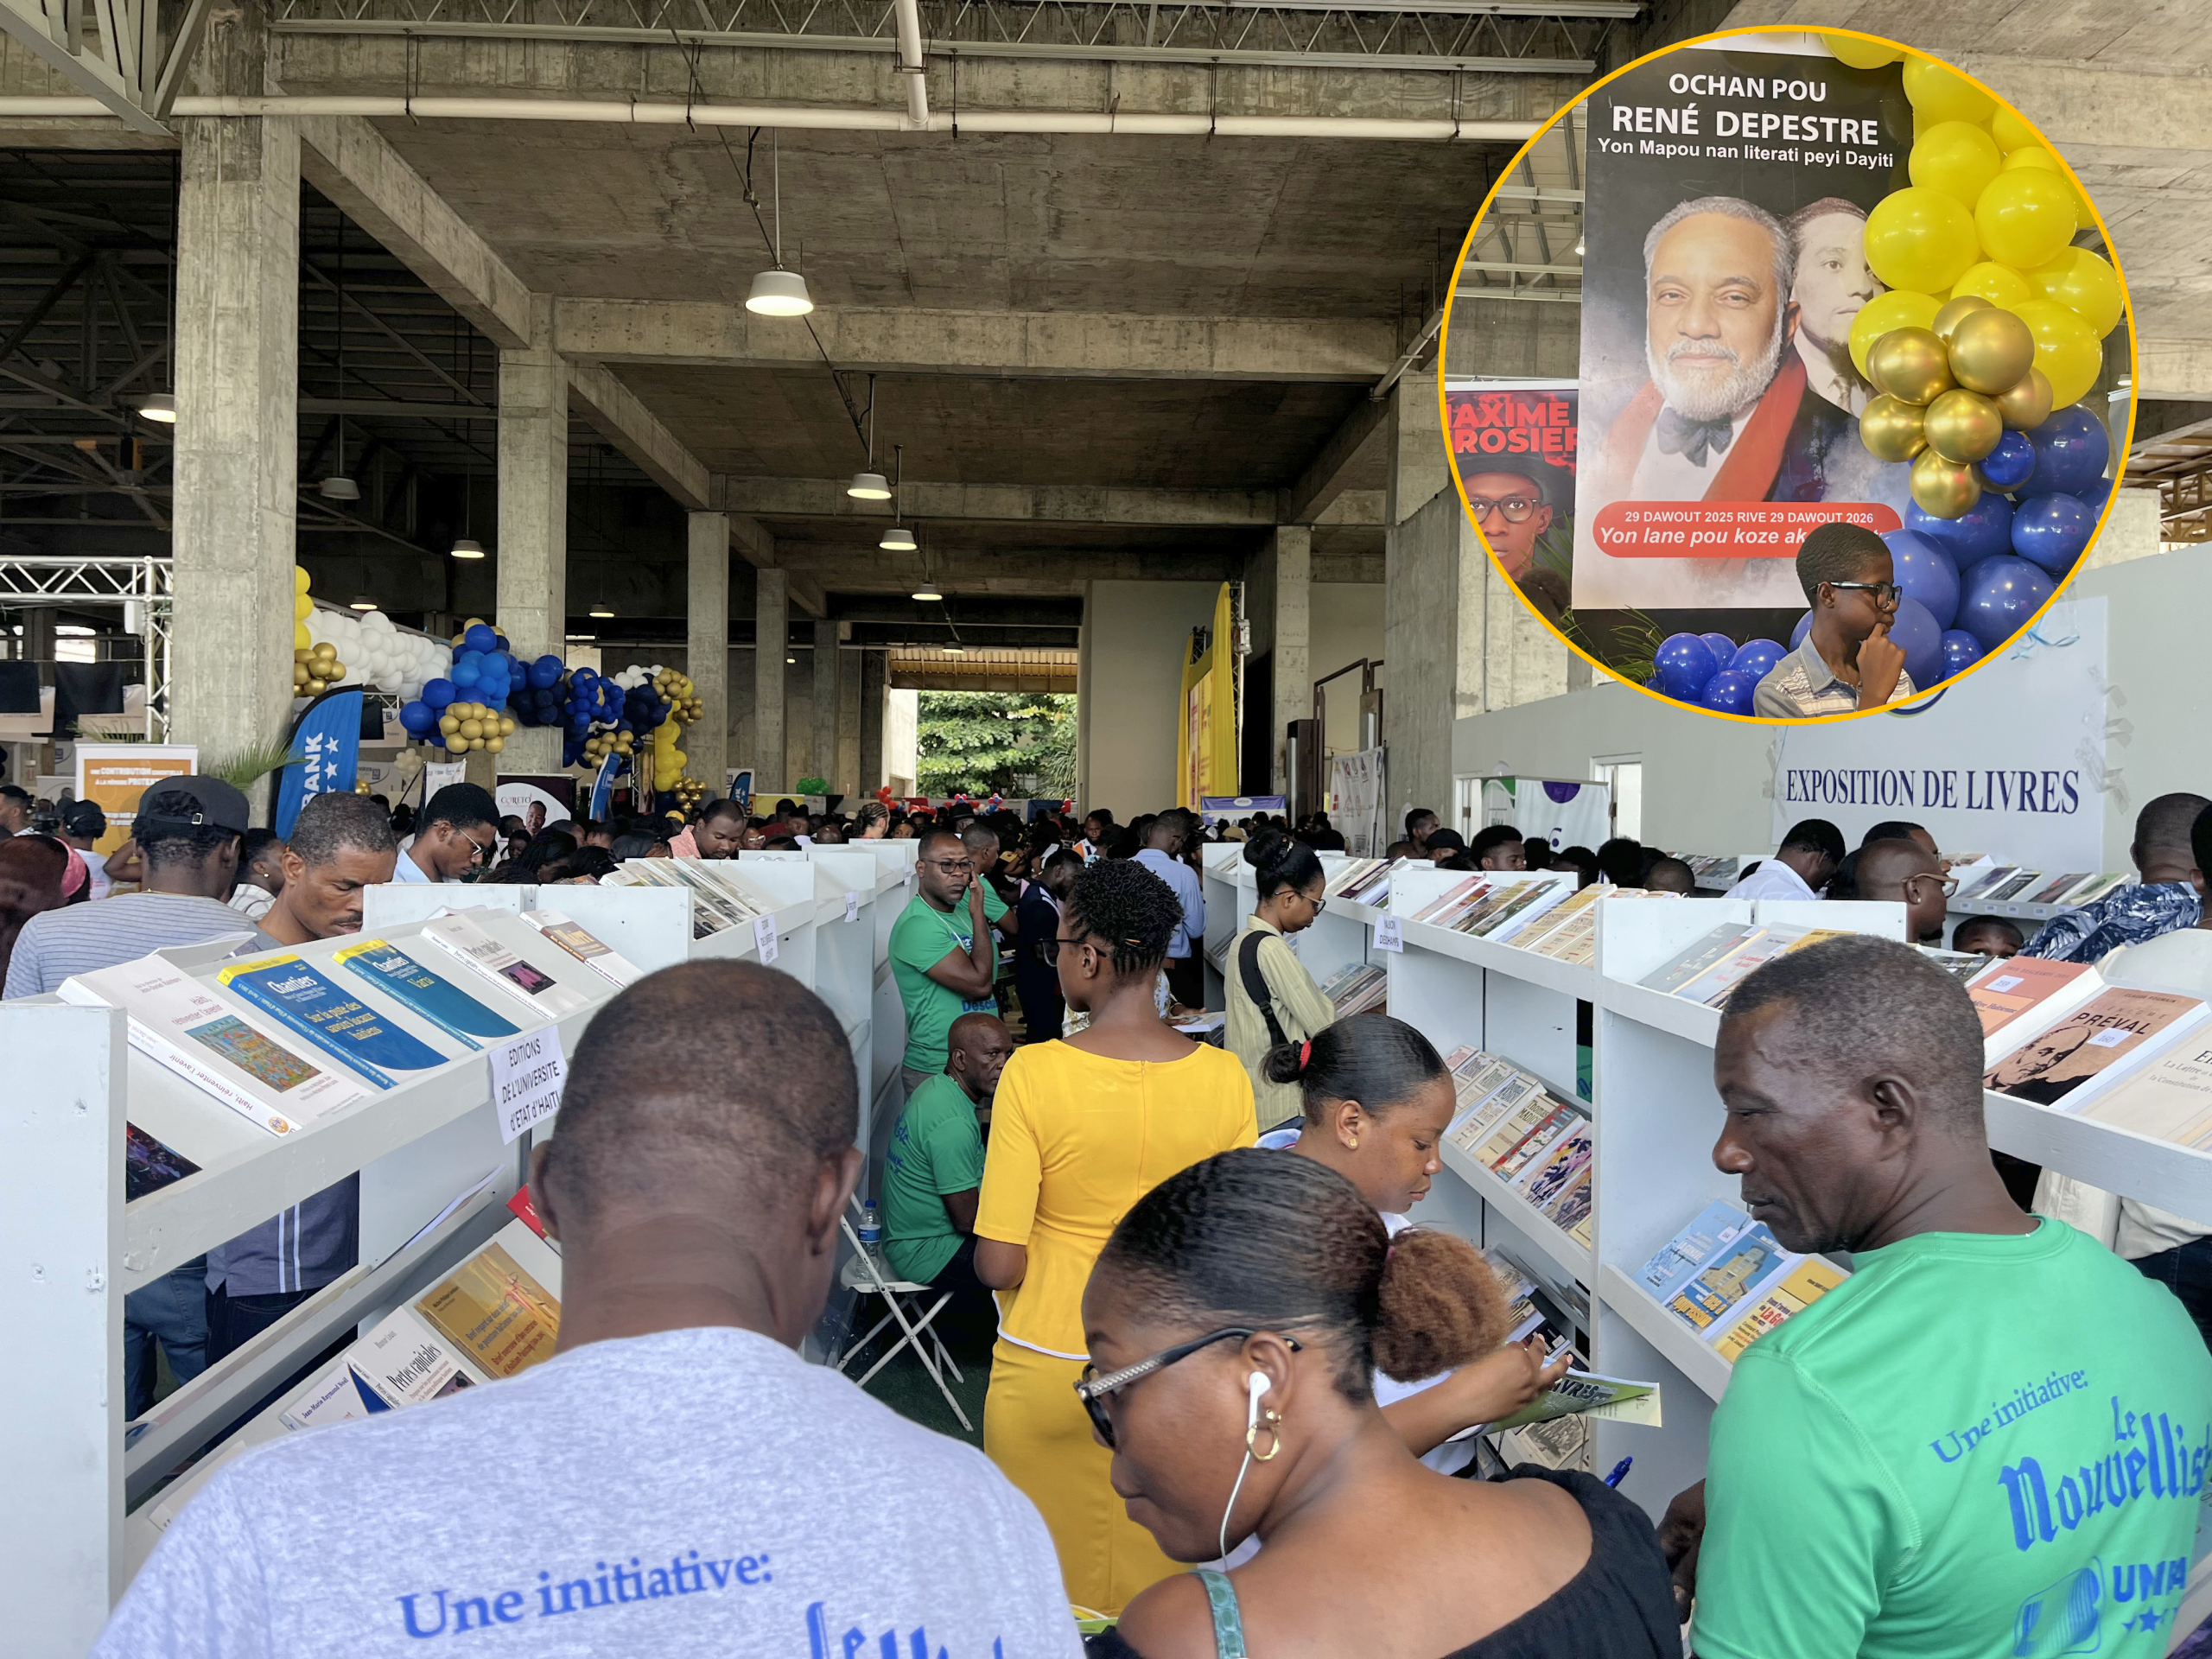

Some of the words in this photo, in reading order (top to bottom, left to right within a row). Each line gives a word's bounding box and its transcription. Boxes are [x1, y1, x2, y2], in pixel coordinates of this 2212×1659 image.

[1669, 73, 1764, 99] OCHAN
[1772, 79, 1827, 102] POU
[1612, 103, 1700, 135] RENÉ
[1716, 111, 1878, 145] DEPESTRE
[1597, 138, 1633, 154] Yon
[1639, 139, 1700, 159] Mapou
[1706, 146, 1738, 159] nan
[1744, 144, 1798, 162] literati
[1804, 150, 1840, 168] peyi
[1846, 150, 1893, 169] Dayiti
[1624, 512, 1639, 523] 29
[1643, 512, 1701, 523] DAWOUT
[1705, 512, 1733, 523] 2025
[1737, 512, 1767, 523] RIVE
[1770, 512, 1784, 524] 29
[1788, 512, 1843, 524] DAWOUT
[1846, 512, 1875, 524] 2026
[1600, 527, 1637, 543] Yon
[1643, 527, 1685, 544] lane
[1689, 532, 1727, 548] pou
[1733, 527, 1779, 544] koze
[1784, 528, 1808, 544] ak
[1786, 769, 1915, 807] EXPOSITION
[1922, 769, 1958, 809] DE
[1966, 769, 2080, 814] LIVRES
[372, 957, 410, 973] Chantiers
[266, 975, 318, 995] Chantiers
[407, 976, 435, 989] Varia
[2147, 995, 2177, 1003] ROUMAIN
[304, 1012, 321, 1024] Sur
[320, 1010, 330, 1020] la
[344, 1001, 362, 1013] des
[2070, 1012, 2152, 1035] PRÉVAL
[168, 1053, 196, 1074] l'avenir
[509, 1038, 541, 1067] EDITIONS
[195, 1071, 234, 1097] réinventer
[502, 1083, 512, 1104] DE
[511, 1059, 560, 1098] L'UNIVERSITE
[2158, 1077, 2201, 1090] Constitution
[235, 1093, 254, 1111] Haïti,
[510, 1104, 531, 1131] d'ETAT
[531, 1090, 562, 1118] d'HAITI
[1525, 1098, 1550, 1119] Thomas
[1668, 1290, 1715, 1329] l'oppression
[1700, 1290, 1724, 1312] face
[1758, 1306, 1777, 1320] La
[473, 1318, 491, 1336] regard
[386, 1363, 418, 1392] Pertes
[410, 1344, 442, 1374] capitales
[302, 1401, 324, 1419] Jean-Marie
[321, 1384, 340, 1405] Raymond
[337, 1376, 349, 1389] Noël
[374, 1382, 388, 1395] Pertes
[1928, 1417, 1993, 1463] Une
[1992, 1370, 2088, 1428] initiative:
[2111, 1395, 2137, 1443] Le
[395, 1587, 524, 1640] Une
[536, 1549, 773, 1618] initiative:
